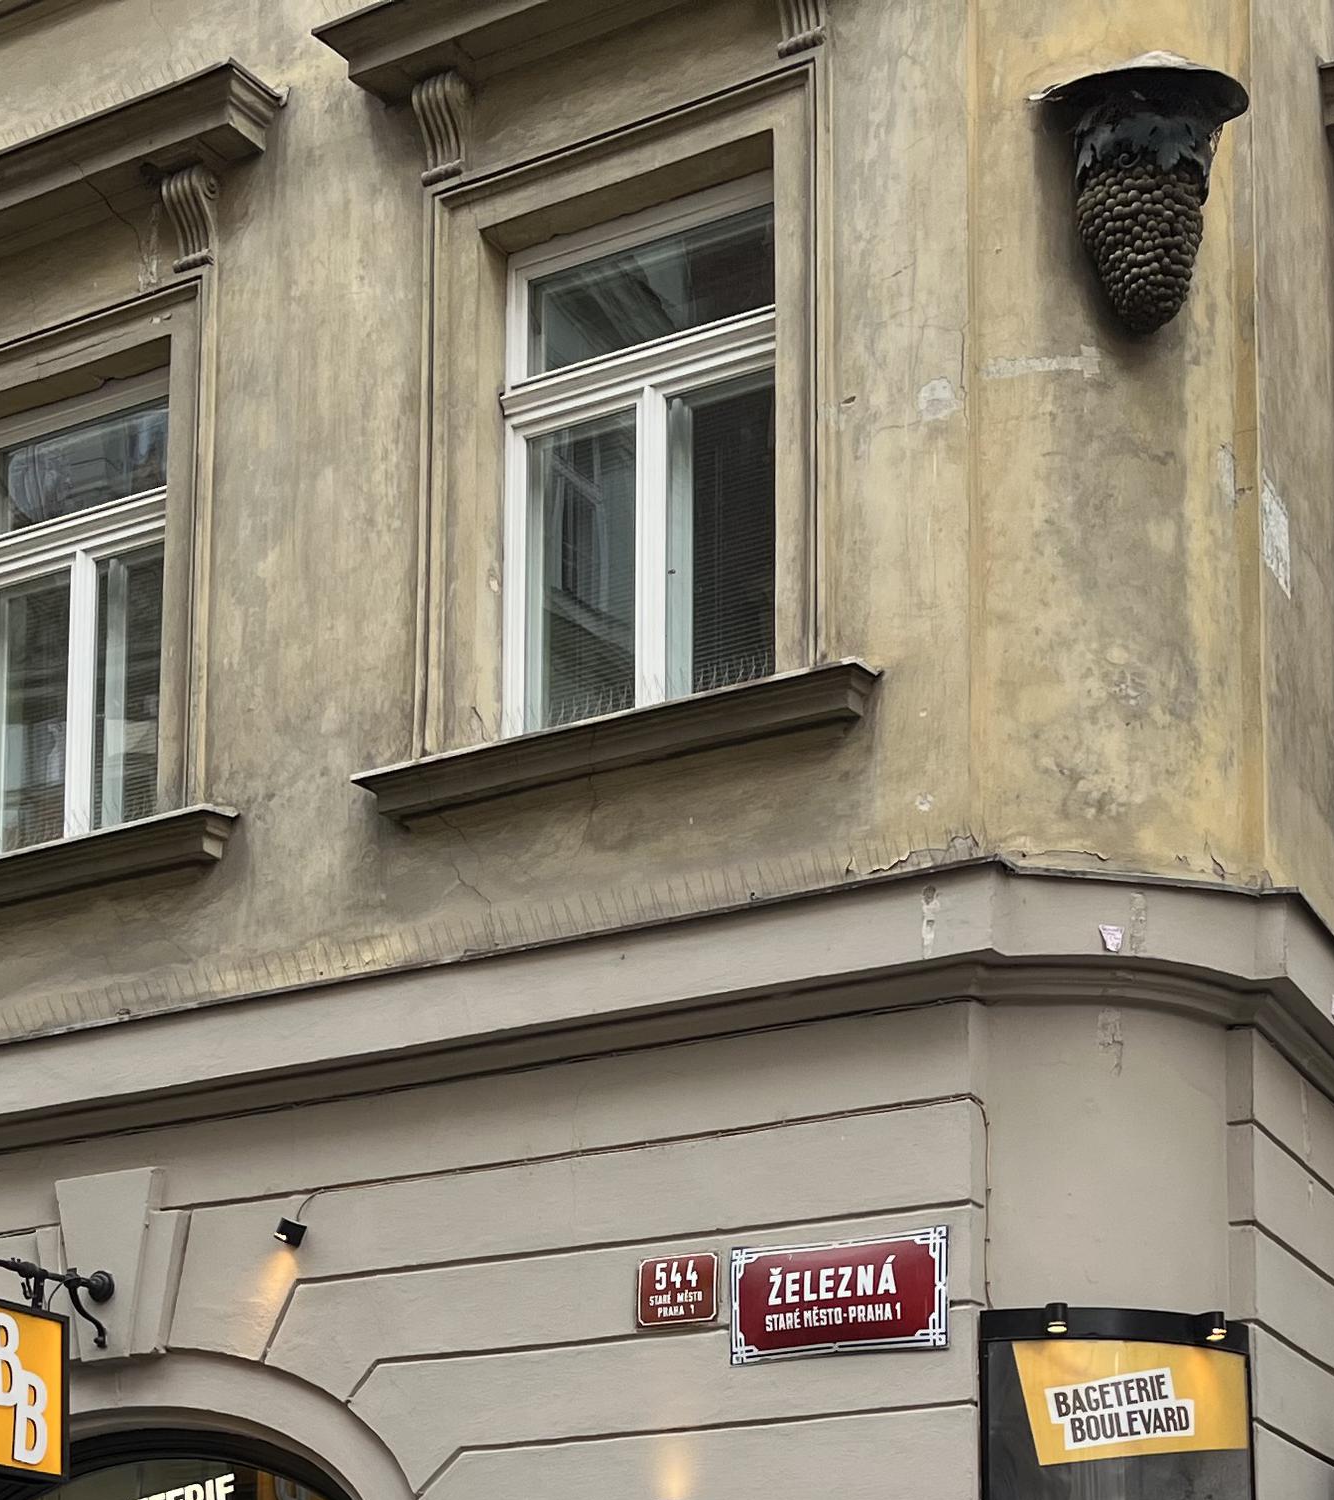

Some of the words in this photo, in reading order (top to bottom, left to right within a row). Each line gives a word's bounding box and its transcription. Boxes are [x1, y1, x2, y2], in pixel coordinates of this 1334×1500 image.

[654, 1259, 699, 1291] 544
[768, 1255, 897, 1306] ŽELEZNÁ
[649, 1290, 672, 1305] STARÉ
[677, 1288, 703, 1304] MĚSTO
[657, 1305, 685, 1318] PRAHA
[765, 1310, 801, 1332] STARÉ
[895, 1302, 902, 1321] 1
[1054, 1374, 1168, 1418] BAGETERIE
[1070, 1406, 1190, 1443] BOULEVARD
